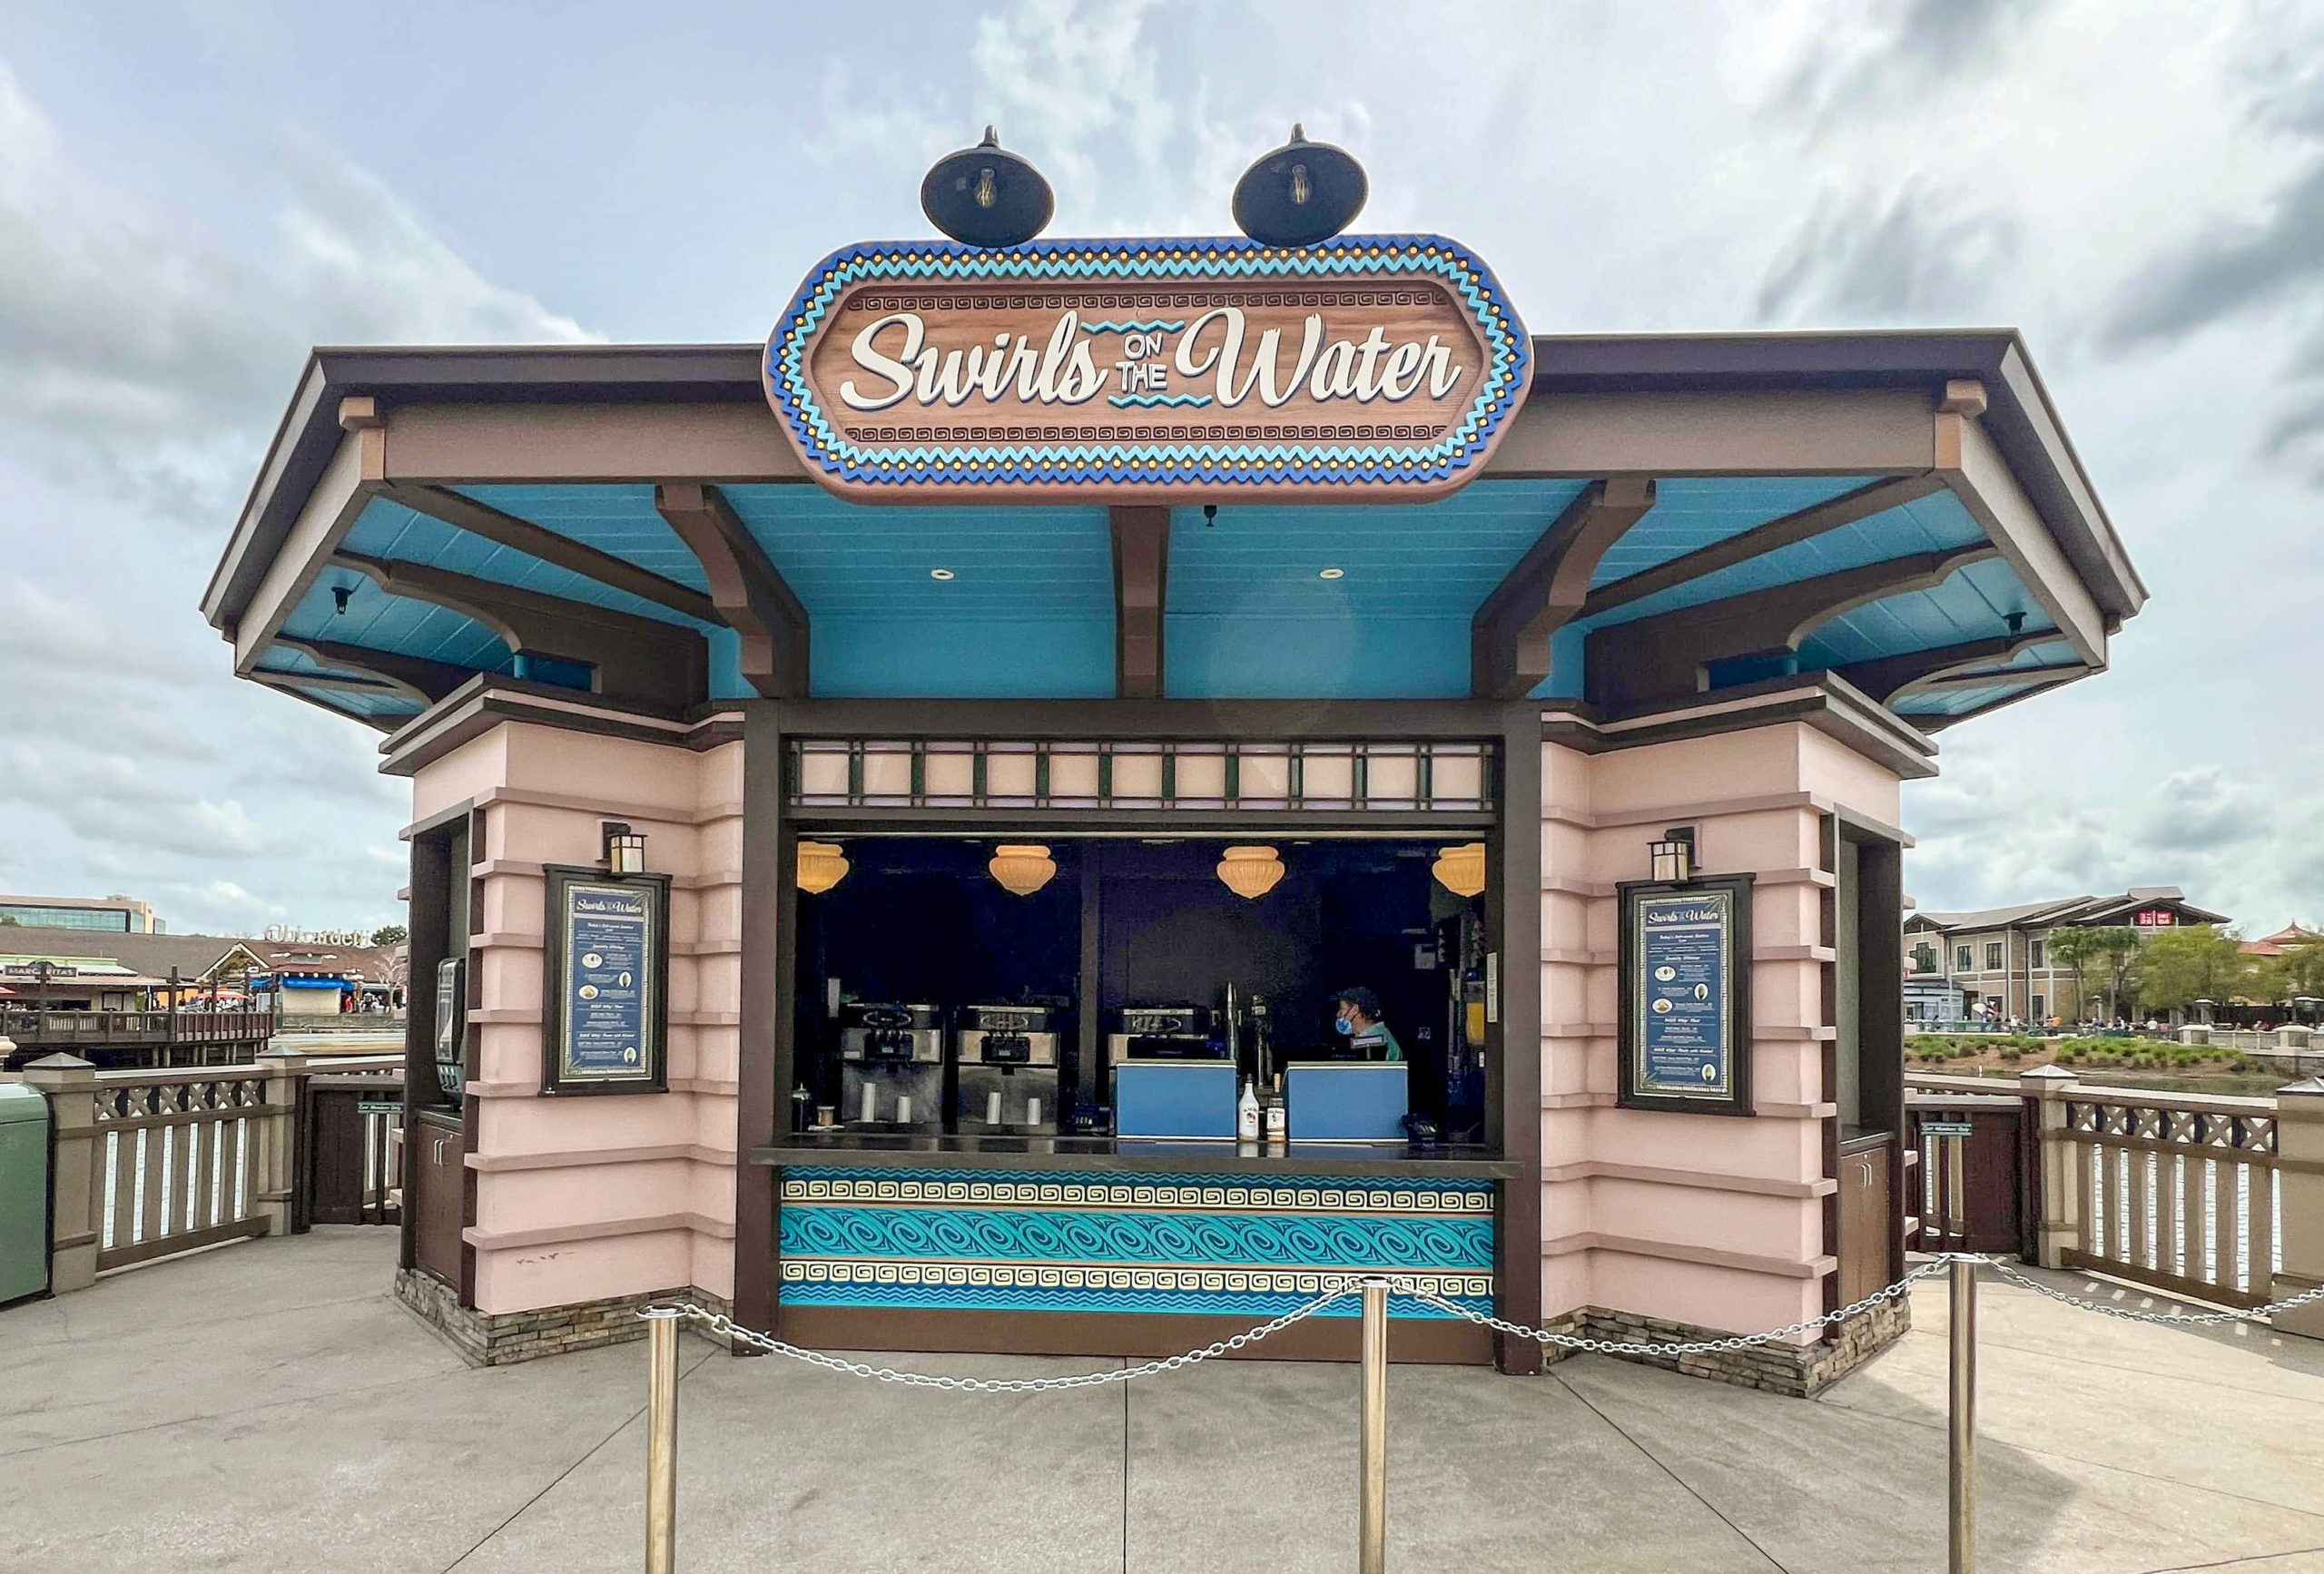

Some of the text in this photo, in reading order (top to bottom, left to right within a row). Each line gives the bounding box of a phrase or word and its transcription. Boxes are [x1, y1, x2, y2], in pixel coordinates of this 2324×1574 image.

[840, 307, 1462, 410] Swirls Water
[1123, 332, 1164, 360] ON
[1115, 360, 1168, 393] THE
[8, 967, 74, 976] MARGRITAS
